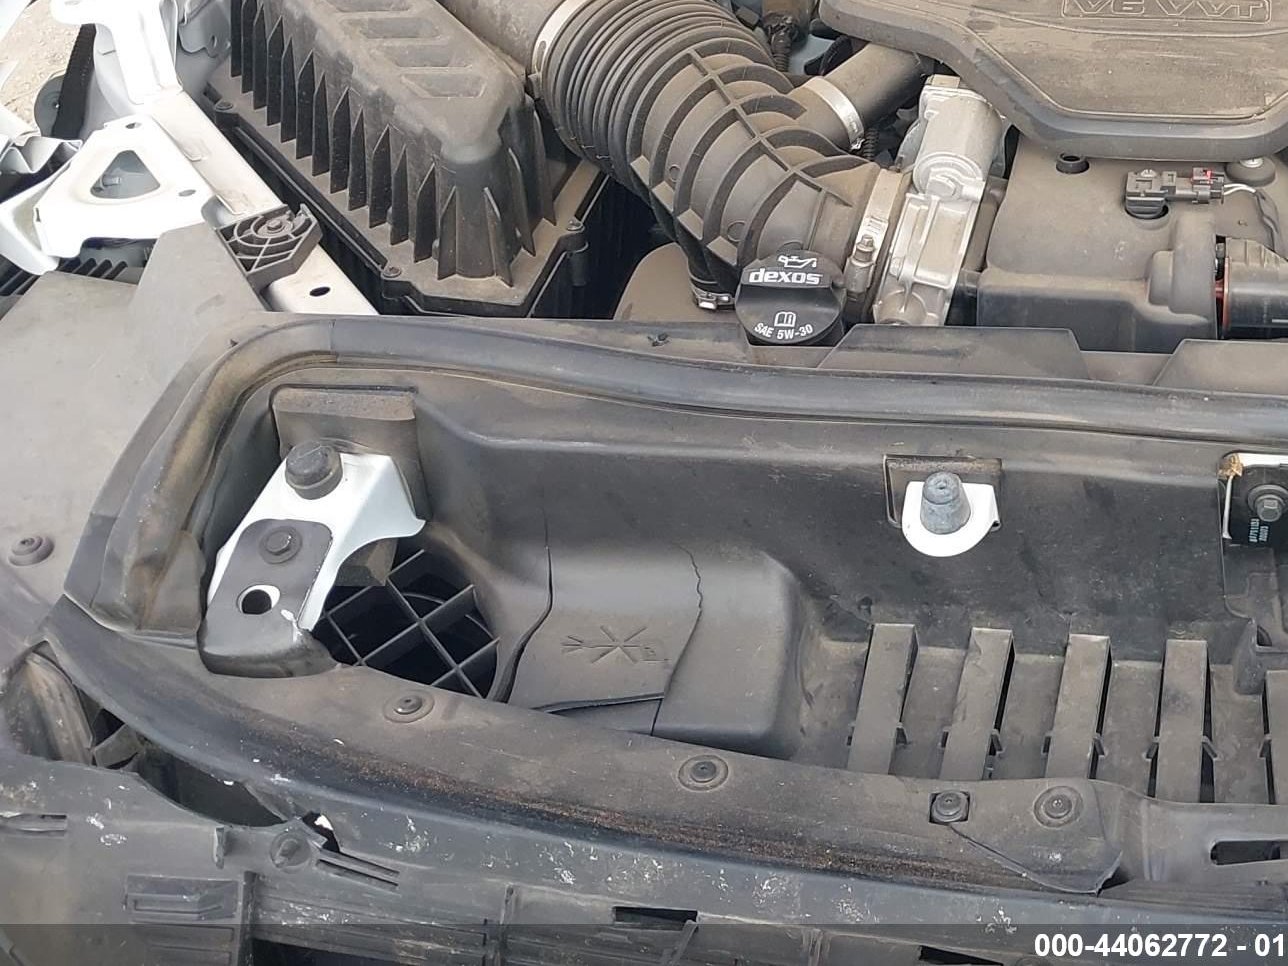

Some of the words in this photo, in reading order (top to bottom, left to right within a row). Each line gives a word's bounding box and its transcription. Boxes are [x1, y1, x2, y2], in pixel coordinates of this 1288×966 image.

[749, 268, 823, 284] dexos
[754, 322, 775, 338] SAE
[777, 324, 813, 339] 5W-30
